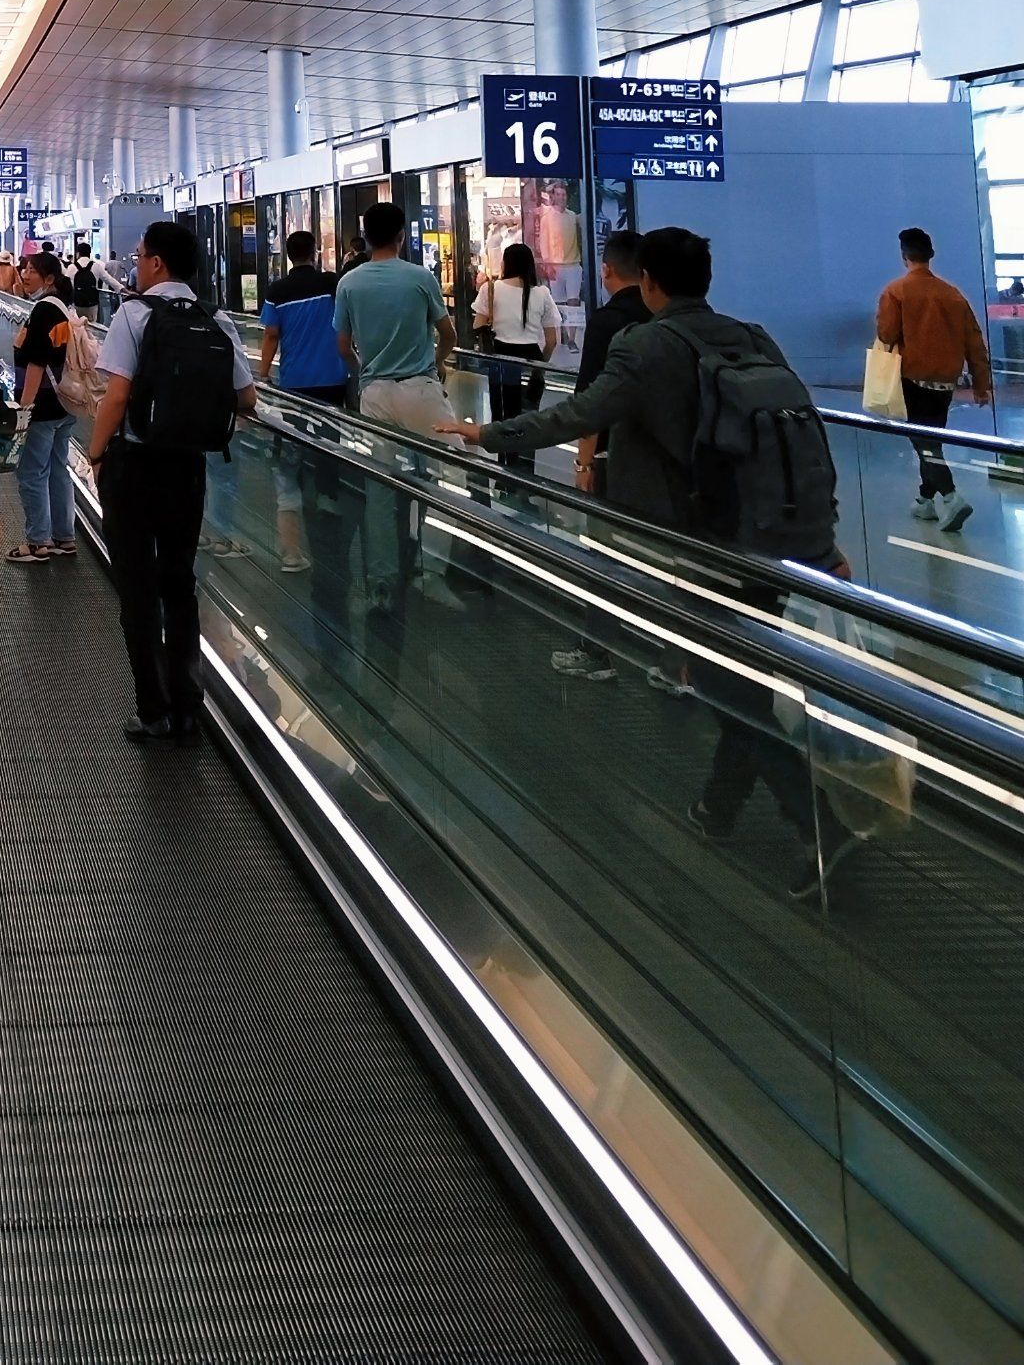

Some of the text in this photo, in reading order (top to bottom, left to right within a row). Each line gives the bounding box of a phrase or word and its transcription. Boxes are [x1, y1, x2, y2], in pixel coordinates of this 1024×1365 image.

[528, 91, 557, 101] 登机口
[620, 82, 662, 97] 17-63
[599, 107, 664, 123] 45A-45C/63A-63C
[505, 121, 560, 165] 16
